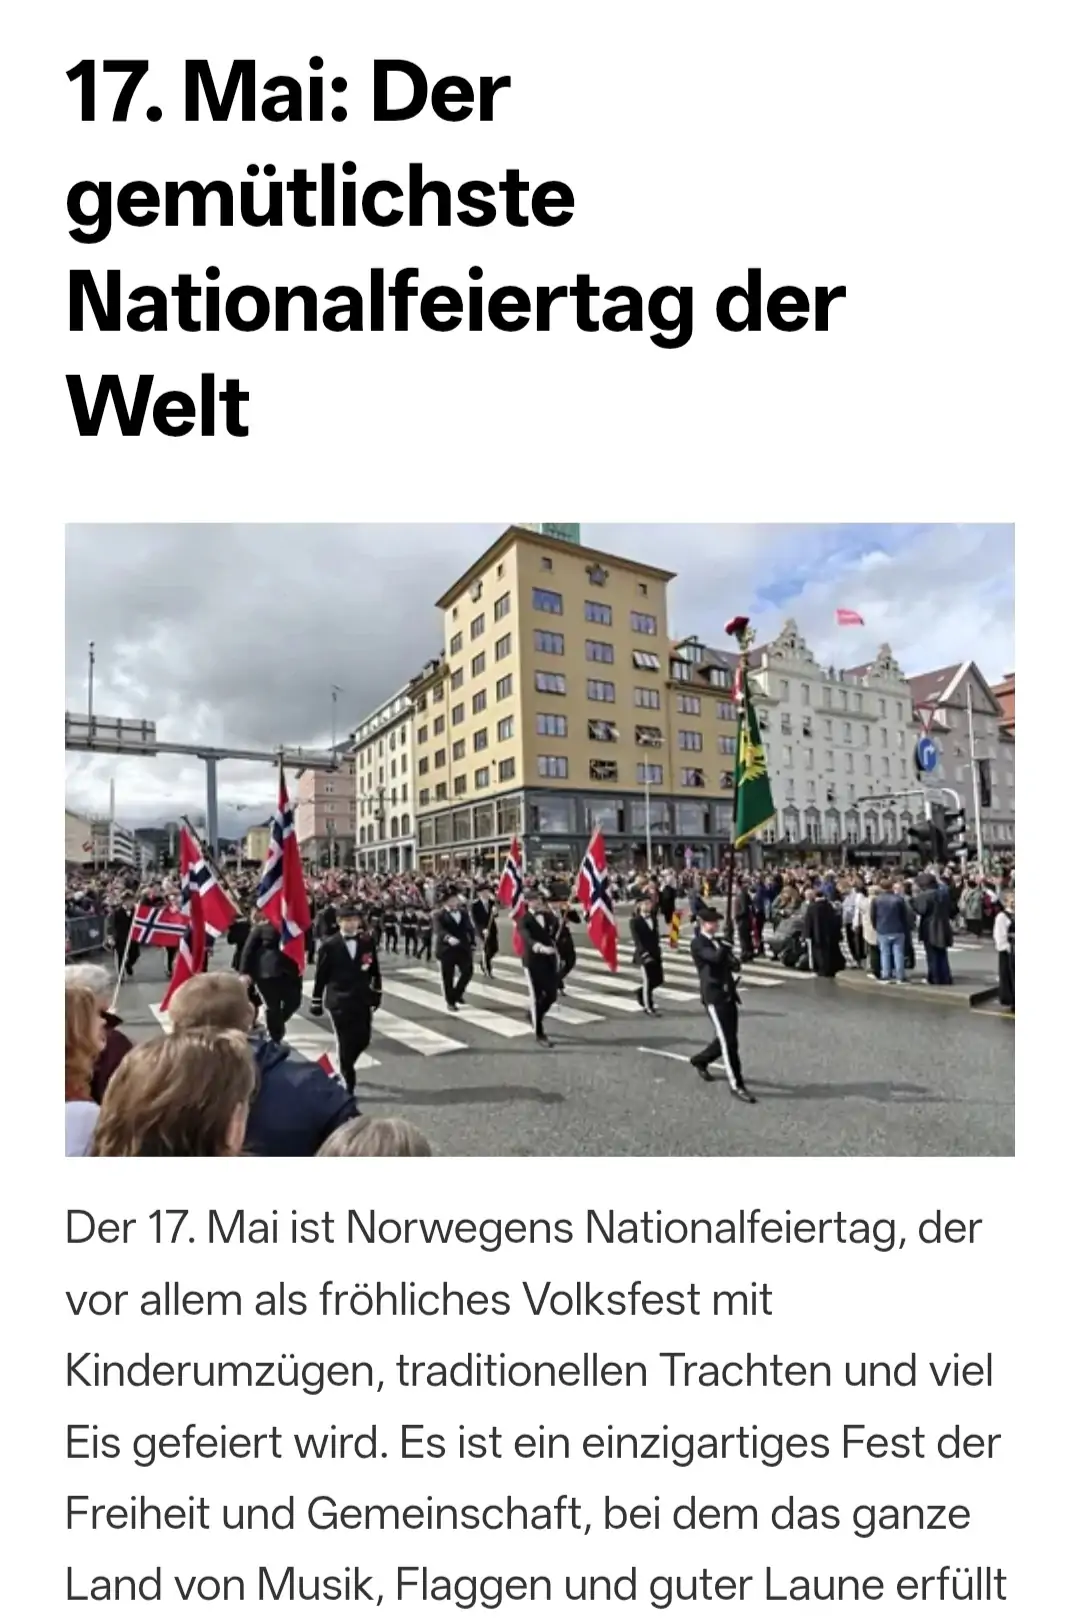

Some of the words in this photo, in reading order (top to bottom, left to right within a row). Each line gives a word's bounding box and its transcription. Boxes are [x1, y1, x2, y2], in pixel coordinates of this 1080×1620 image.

[66, 60, 162, 122] 17.
[185, 56, 347, 122] Mai:
[374, 59, 511, 122] Der
[67, 161, 574, 244] gemütlichste
[70, 266, 693, 349] Nationalfeiertag
[716, 268, 846, 332] der
[65, 373, 249, 437] Welt
[68, 1210, 136, 1243] Der
[149, 1210, 194, 1243] 17.
[209, 1210, 277, 1243] Mai
[292, 1210, 334, 1243] ist
[349, 1210, 573, 1252] Norwegens
[588, 1209, 905, 1252] Nationalfeiertag,
[919, 1210, 982, 1243] der
[66, 1291, 128, 1315] vor
[141, 1282, 241, 1315] allem
[256, 1282, 307, 1315] als
[319, 1281, 510, 1315] fröhliches
[522, 1281, 700, 1315] Volksfest
[714, 1282, 772, 1315] mit
[68, 1353, 383, 1395] Kinderumzügen,
[396, 1353, 646, 1386] traditionellen
[660, 1353, 830, 1386] Trachten
[846, 1353, 915, 1386] und
[929, 1353, 991, 1386] viel
[68, 1425, 120, 1458] Eis
[134, 1424, 282, 1467] gefeiert
[294, 1425, 387, 1458] wird.
[402, 1425, 445, 1458] Es
[459, 1425, 502, 1458] ist
[515, 1425, 569, 1458] ein
[583, 1425, 829, 1467] einzigartiges
[844, 1425, 925, 1458] Fest
[938, 1425, 1001, 1458] der
[68, 1496, 209, 1529] Freiheit
[224, 1496, 293, 1529] und
[308, 1495, 590, 1535] Gemeinschaft,
[605, 1496, 659, 1529] bei
[674, 1496, 757, 1529] dem
[772, 1496, 840, 1529] das
[853, 1505, 970, 1538] ganze
[68, 1567, 160, 1600] Land
[174, 1576, 244, 1600] von
[259, 1567, 383, 1606] Musik,
[398, 1567, 551, 1609] Flaggen
[566, 1567, 636, 1600] und
[650, 1569, 753, 1609] guter
[767, 1567, 883, 1600] Laune
[897, 1566, 1006, 1600] erfüllt
